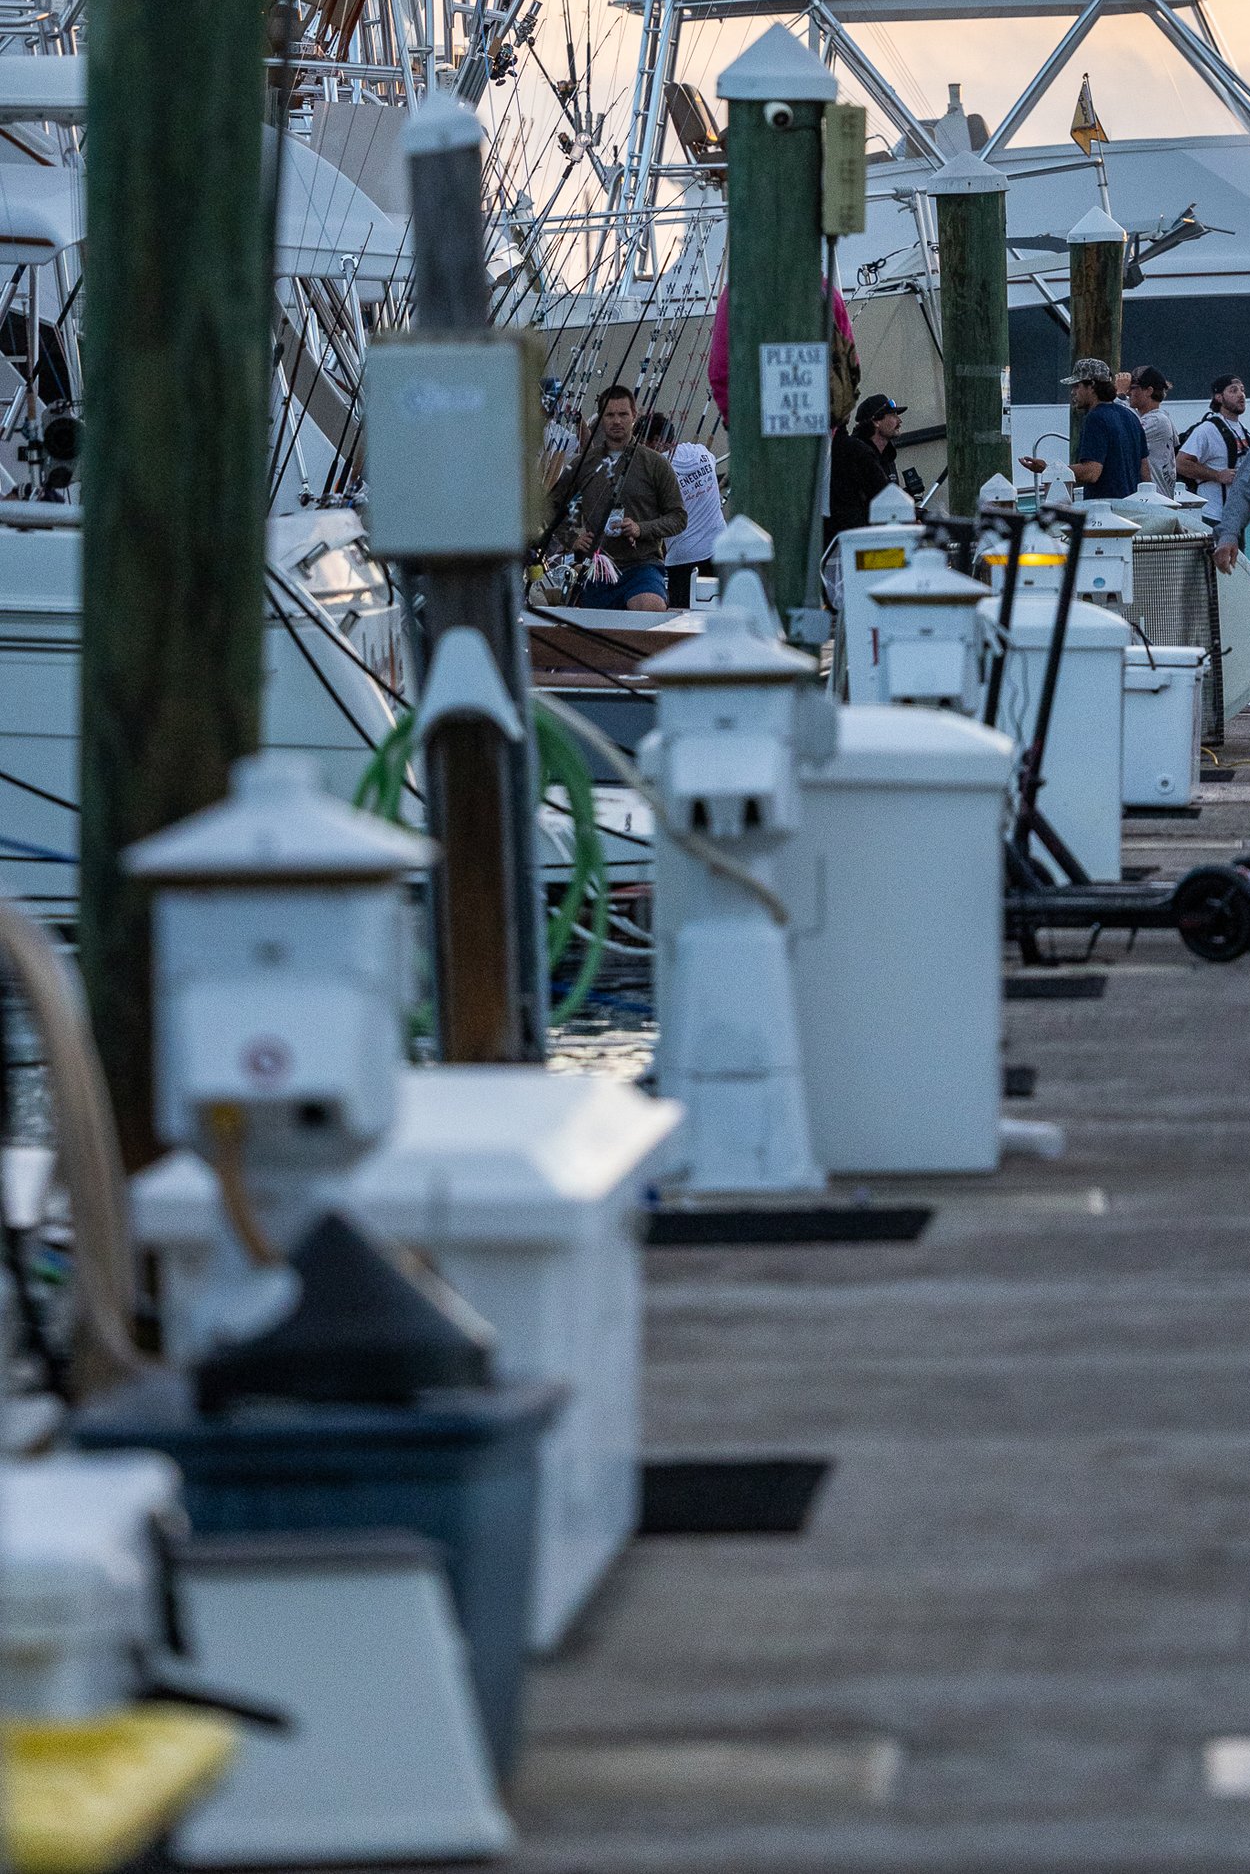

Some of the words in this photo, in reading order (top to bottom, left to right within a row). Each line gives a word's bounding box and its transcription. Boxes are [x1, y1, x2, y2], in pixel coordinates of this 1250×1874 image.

[767, 347, 822, 365] PLEASE
[780, 369, 813, 388] BAG
[780, 391, 811, 410] ALL
[679, 463, 713, 488] ENEGADES
